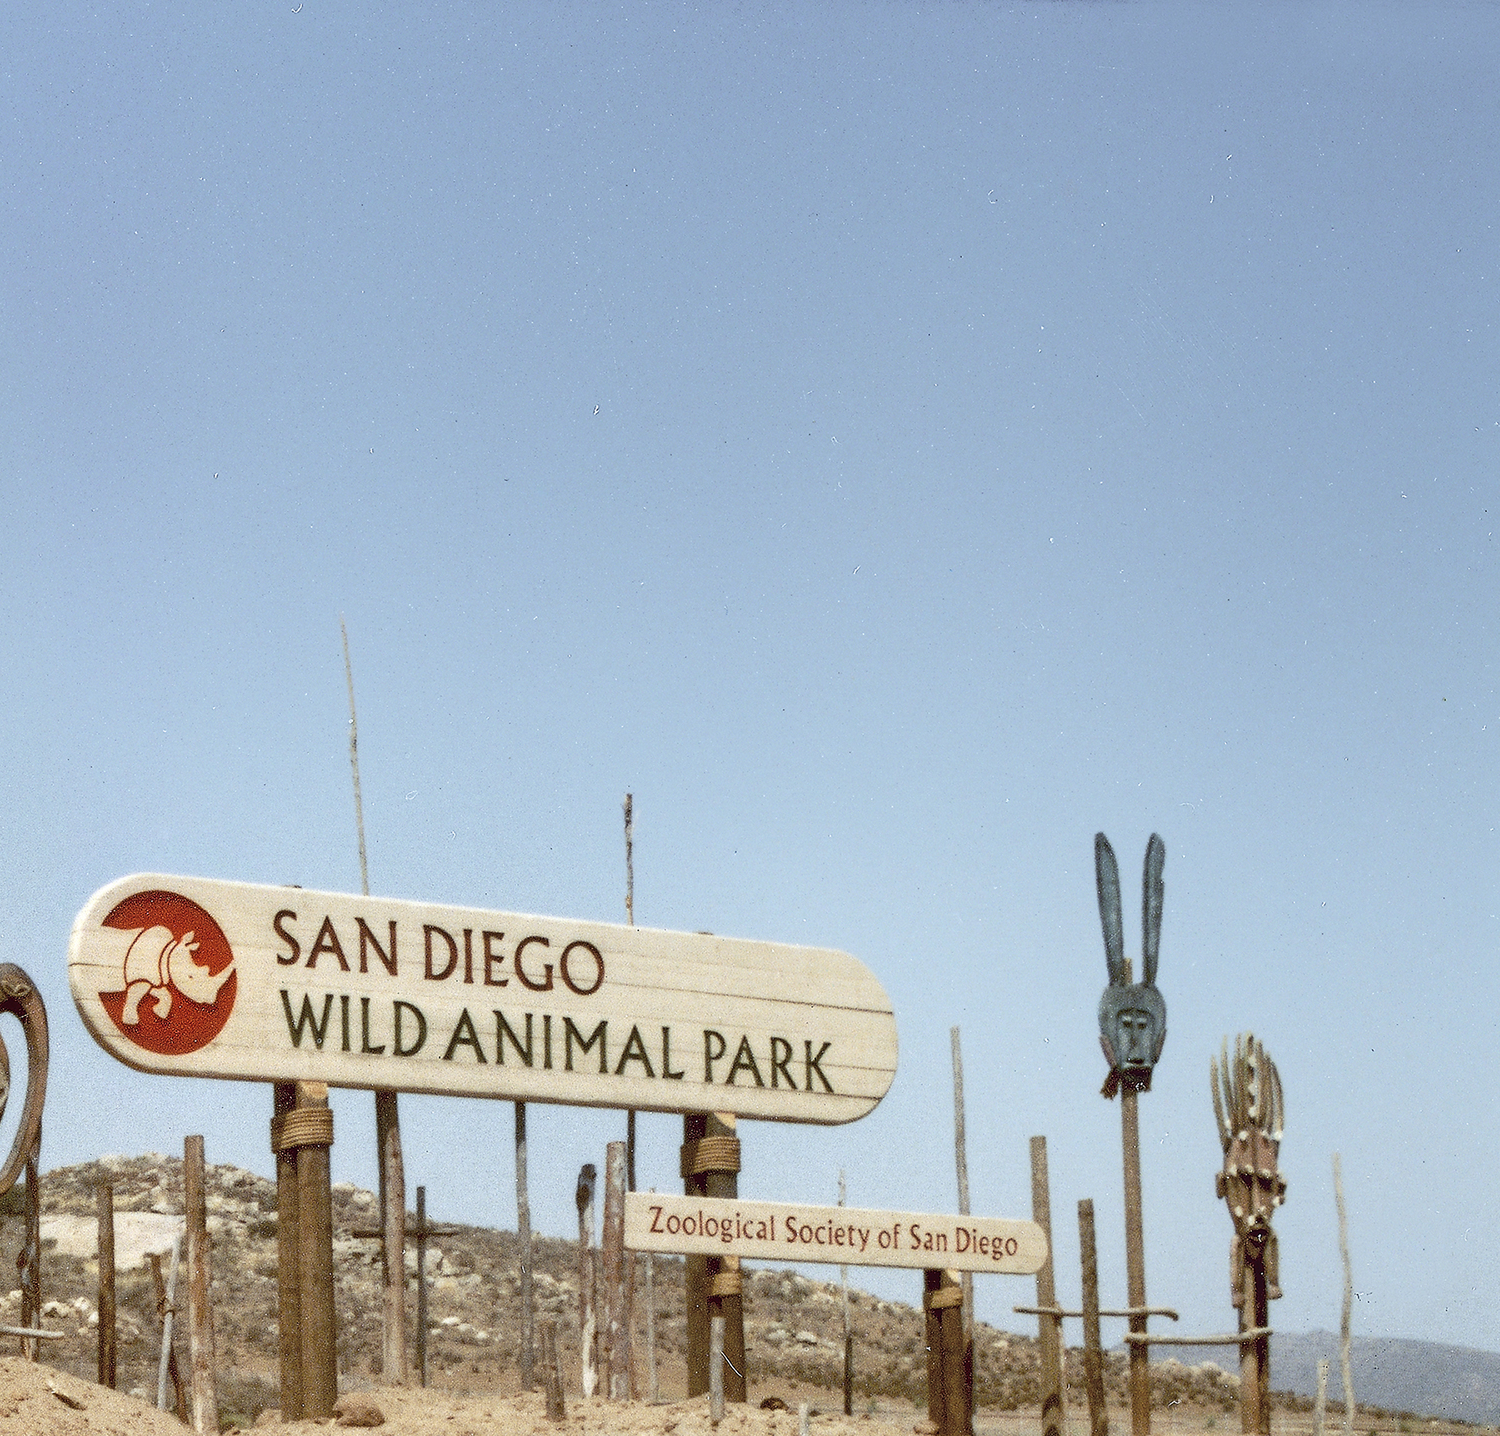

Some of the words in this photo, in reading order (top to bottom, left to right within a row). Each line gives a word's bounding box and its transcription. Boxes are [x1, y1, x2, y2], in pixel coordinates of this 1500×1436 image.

[273, 908, 400, 977] SAN
[423, 923, 606, 996] DIEGO
[279, 989, 429, 1058] WILD
[444, 1008, 686, 1079] ANIMAL
[703, 1030, 835, 1094] PARK
[649, 1206, 775, 1243] Zoological
[786, 1216, 870, 1252] Society
[877, 1222, 902, 1250] of
[910, 1224, 948, 1252] San
[955, 1227, 1018, 1261] Diego
